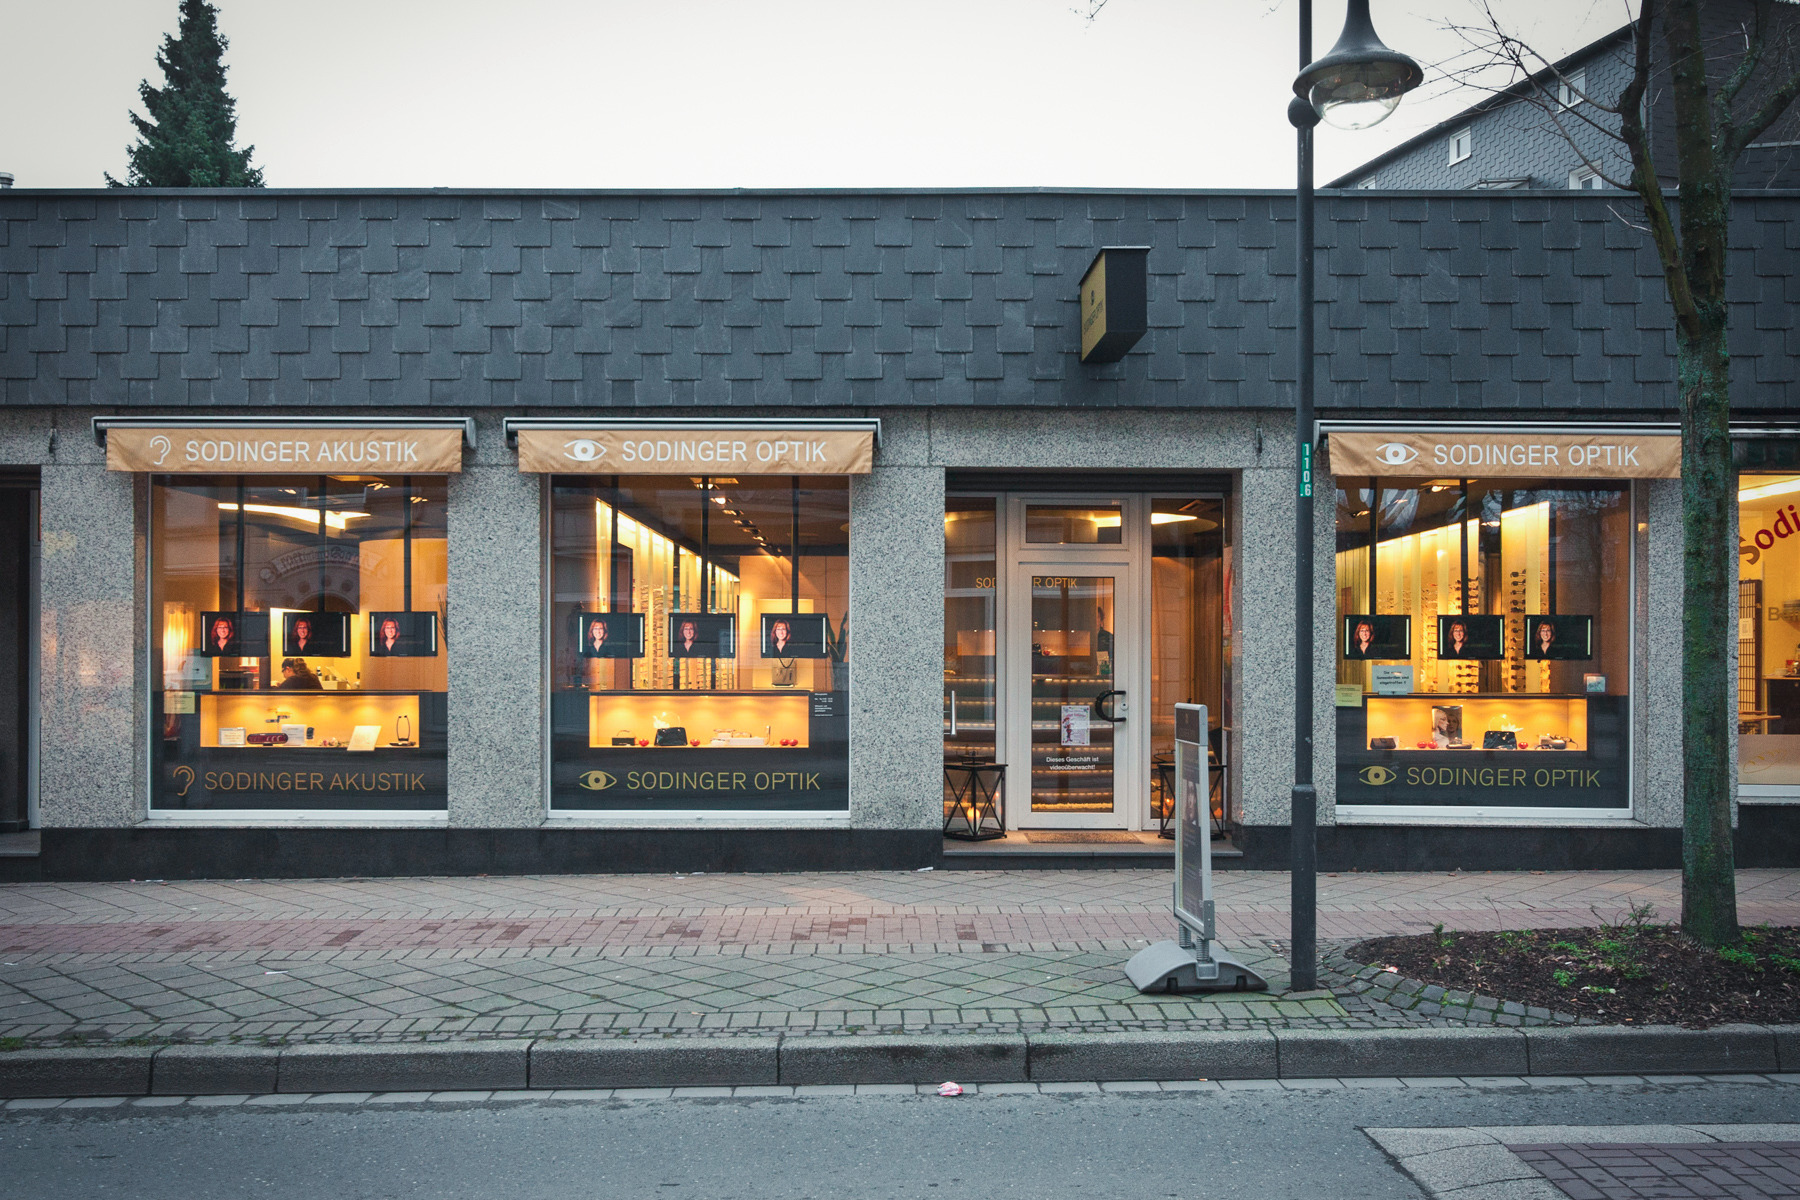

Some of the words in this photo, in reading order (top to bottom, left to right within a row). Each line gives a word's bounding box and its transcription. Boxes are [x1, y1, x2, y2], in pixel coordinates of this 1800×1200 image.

[185, 441, 310, 462] SODINGER
[317, 441, 419, 462] AKUSTIK
[622, 440, 748, 462] SODINGER
[756, 441, 827, 462] OPTIK
[1433, 444, 1560, 466] SODINGER
[1568, 444, 1640, 467] OPTIK
[1045, 577, 1078, 589] OPTIK
[204, 772, 325, 791] SODINGER
[329, 772, 426, 791] AKUSTIK
[626, 771, 747, 790] SODINGER
[753, 771, 821, 791] OPTIK
[1405, 766, 1527, 787] SODINGER
[1533, 768, 1601, 788] OPTIK
